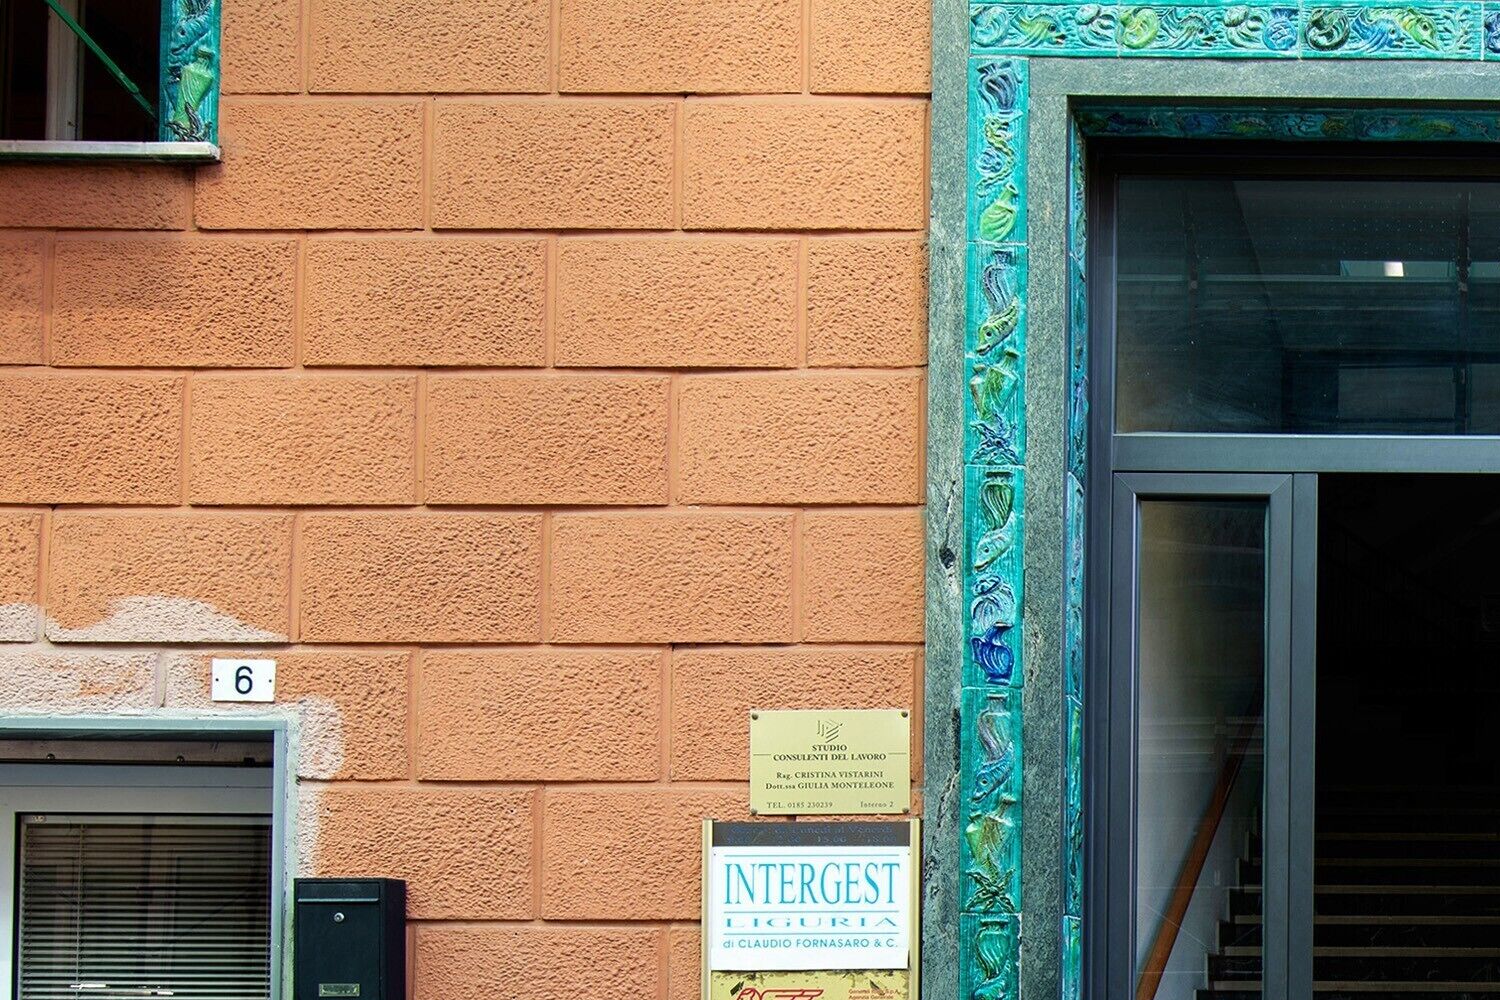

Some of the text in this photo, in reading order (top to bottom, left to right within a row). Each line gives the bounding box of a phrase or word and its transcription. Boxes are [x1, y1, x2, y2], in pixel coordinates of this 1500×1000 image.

[234, 666, 254, 694] 6
[776, 772, 793, 780] Rag.
[794, 771, 836, 779] CRISTINA
[831, 781, 894, 789] MONTELEONE
[724, 862, 900, 905] INTERGEST
[726, 917, 897, 928] LIGURIA
[723, 938, 898, 948] di CLAUDIO FORNASARO & C.
